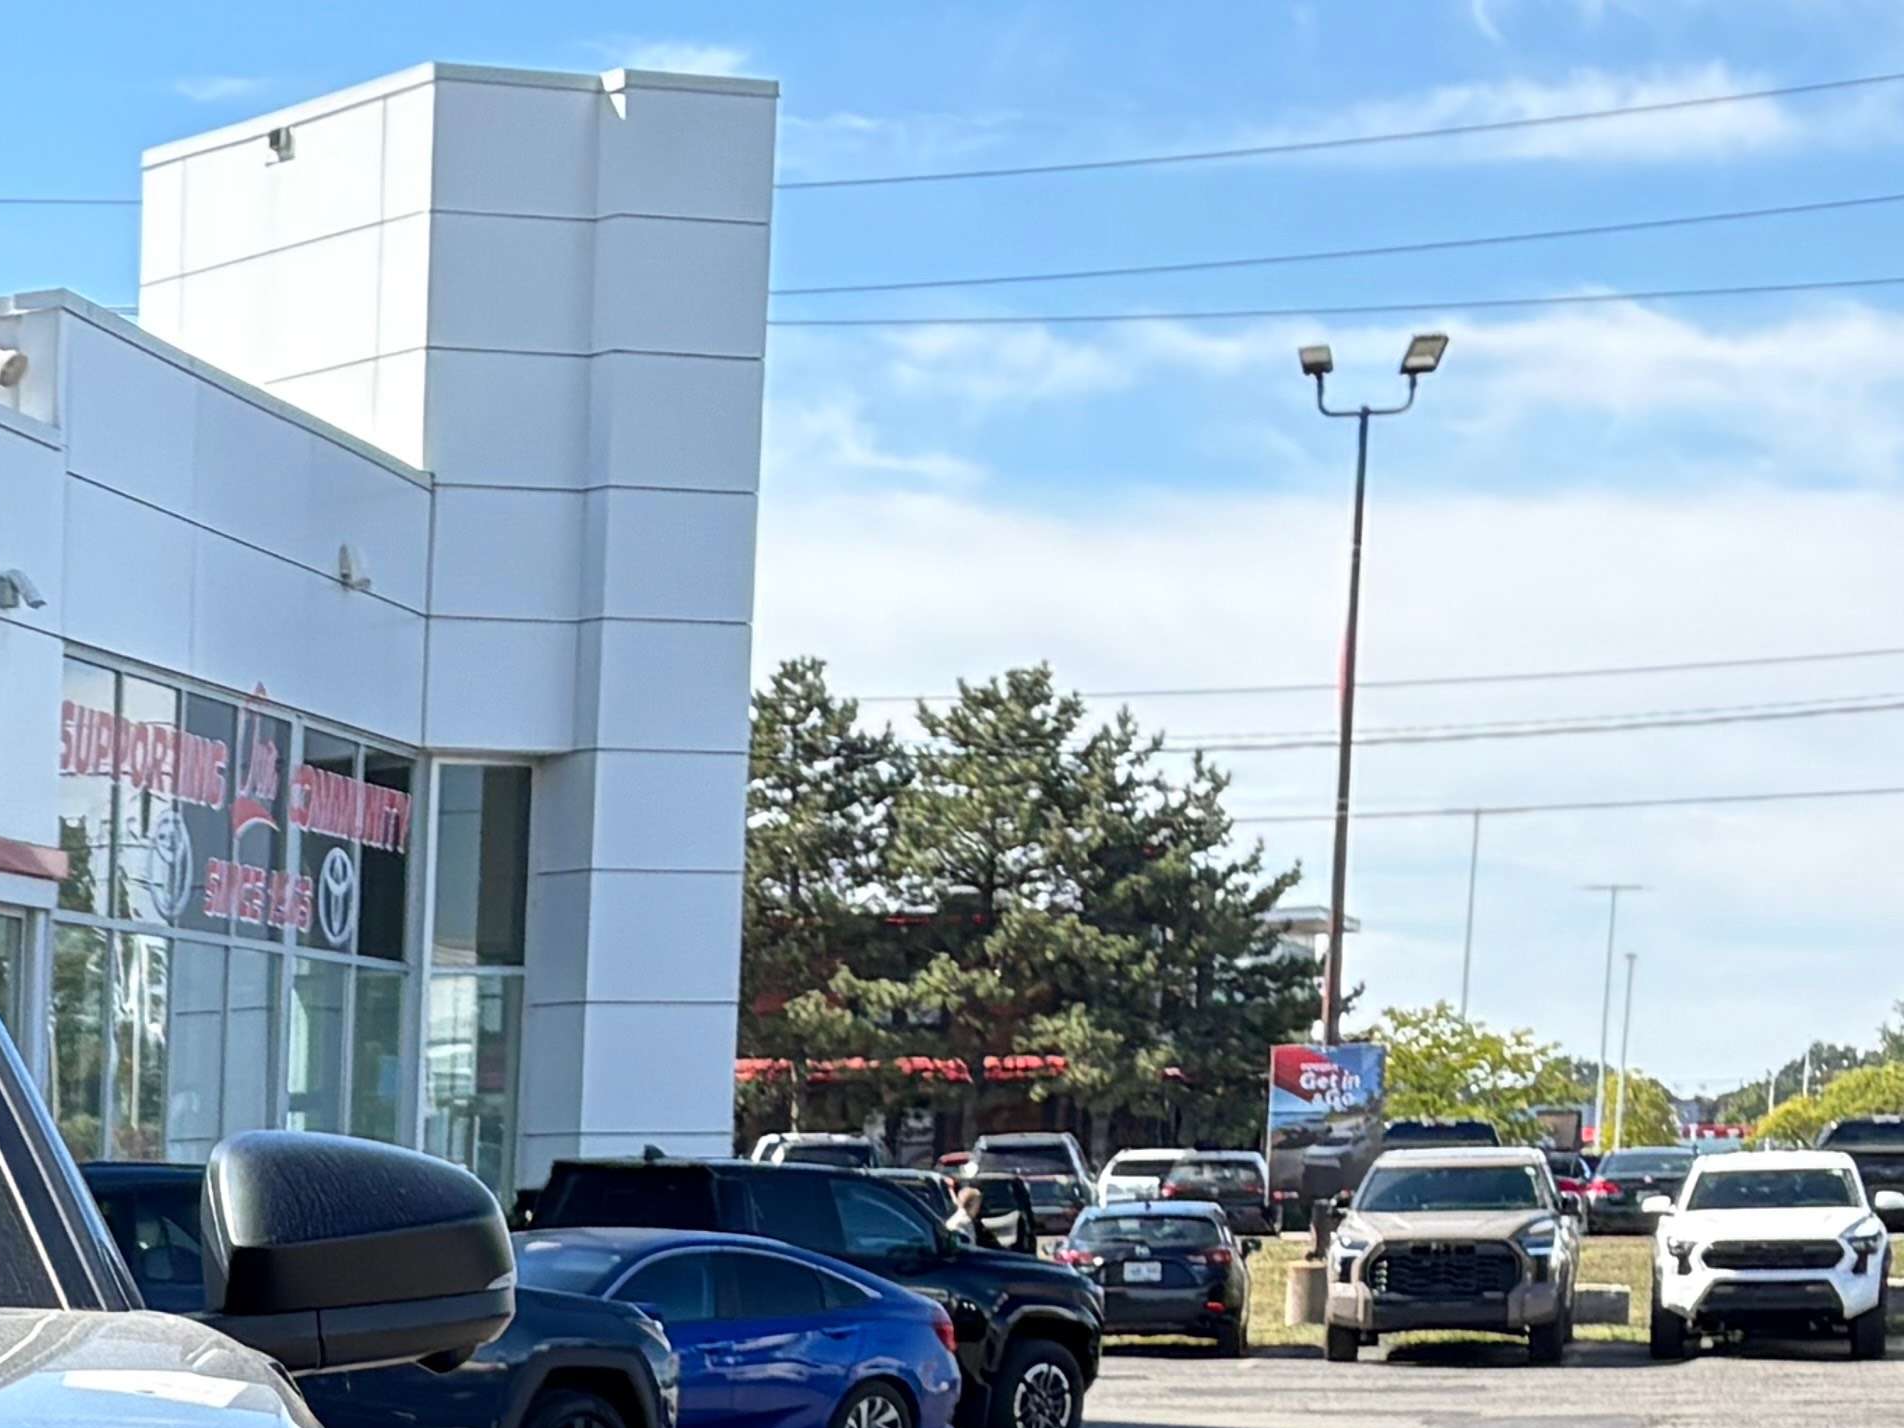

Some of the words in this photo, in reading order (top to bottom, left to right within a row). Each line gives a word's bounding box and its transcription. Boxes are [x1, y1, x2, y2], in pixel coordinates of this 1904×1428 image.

[58, 699, 228, 811] SUPPORTING
[289, 763, 412, 854] COMMUNITY
[203, 857, 264, 924] SINCE
[1299, 1071, 1338, 1091] Get
[1341, 1069, 1361, 1091] in
